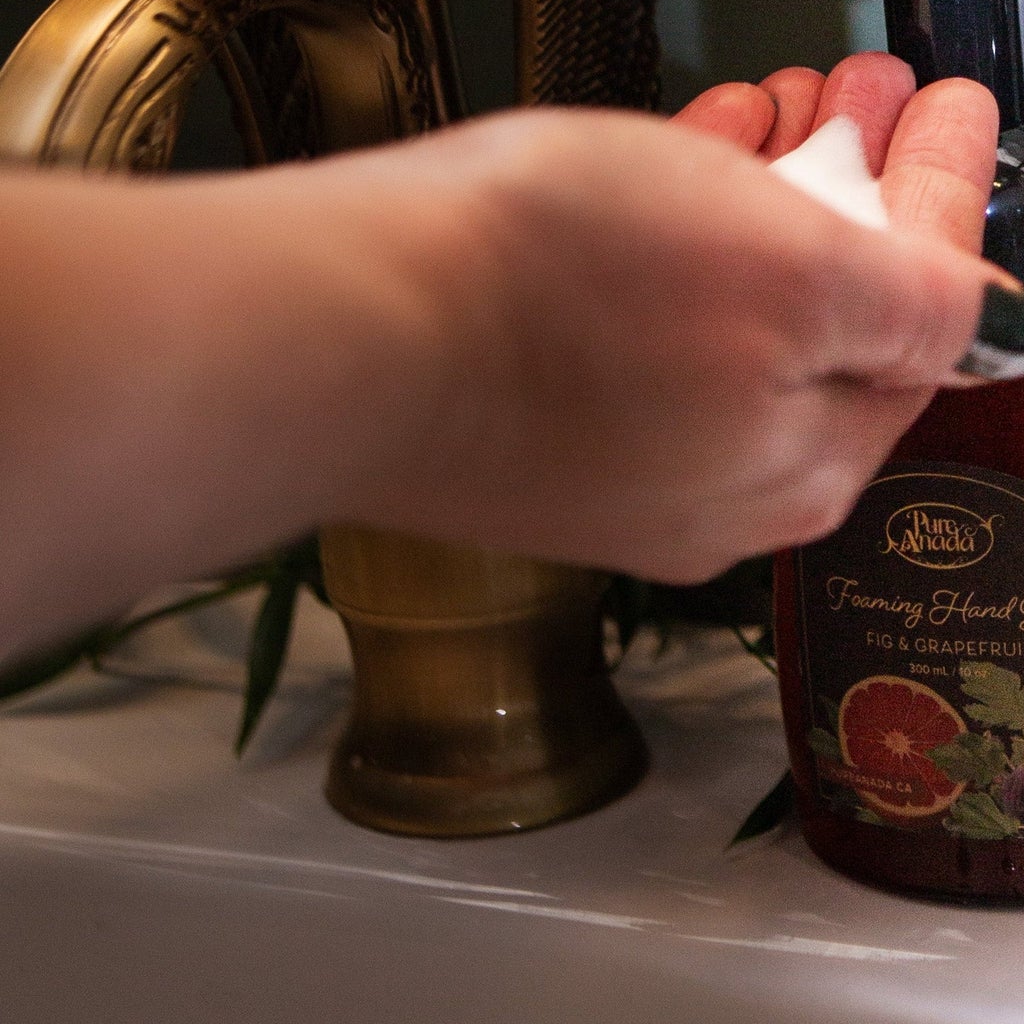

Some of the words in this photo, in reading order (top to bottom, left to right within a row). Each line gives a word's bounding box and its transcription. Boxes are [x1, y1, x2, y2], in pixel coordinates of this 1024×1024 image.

[906, 510, 957, 536] Pure
[900, 530, 975, 554] Anada
[826, 576, 925, 629] Foaming
[928, 590, 1016, 625] Hand
[899, 636, 909, 651] &
[909, 663, 931, 674] 300
[932, 665, 949, 676] mL
